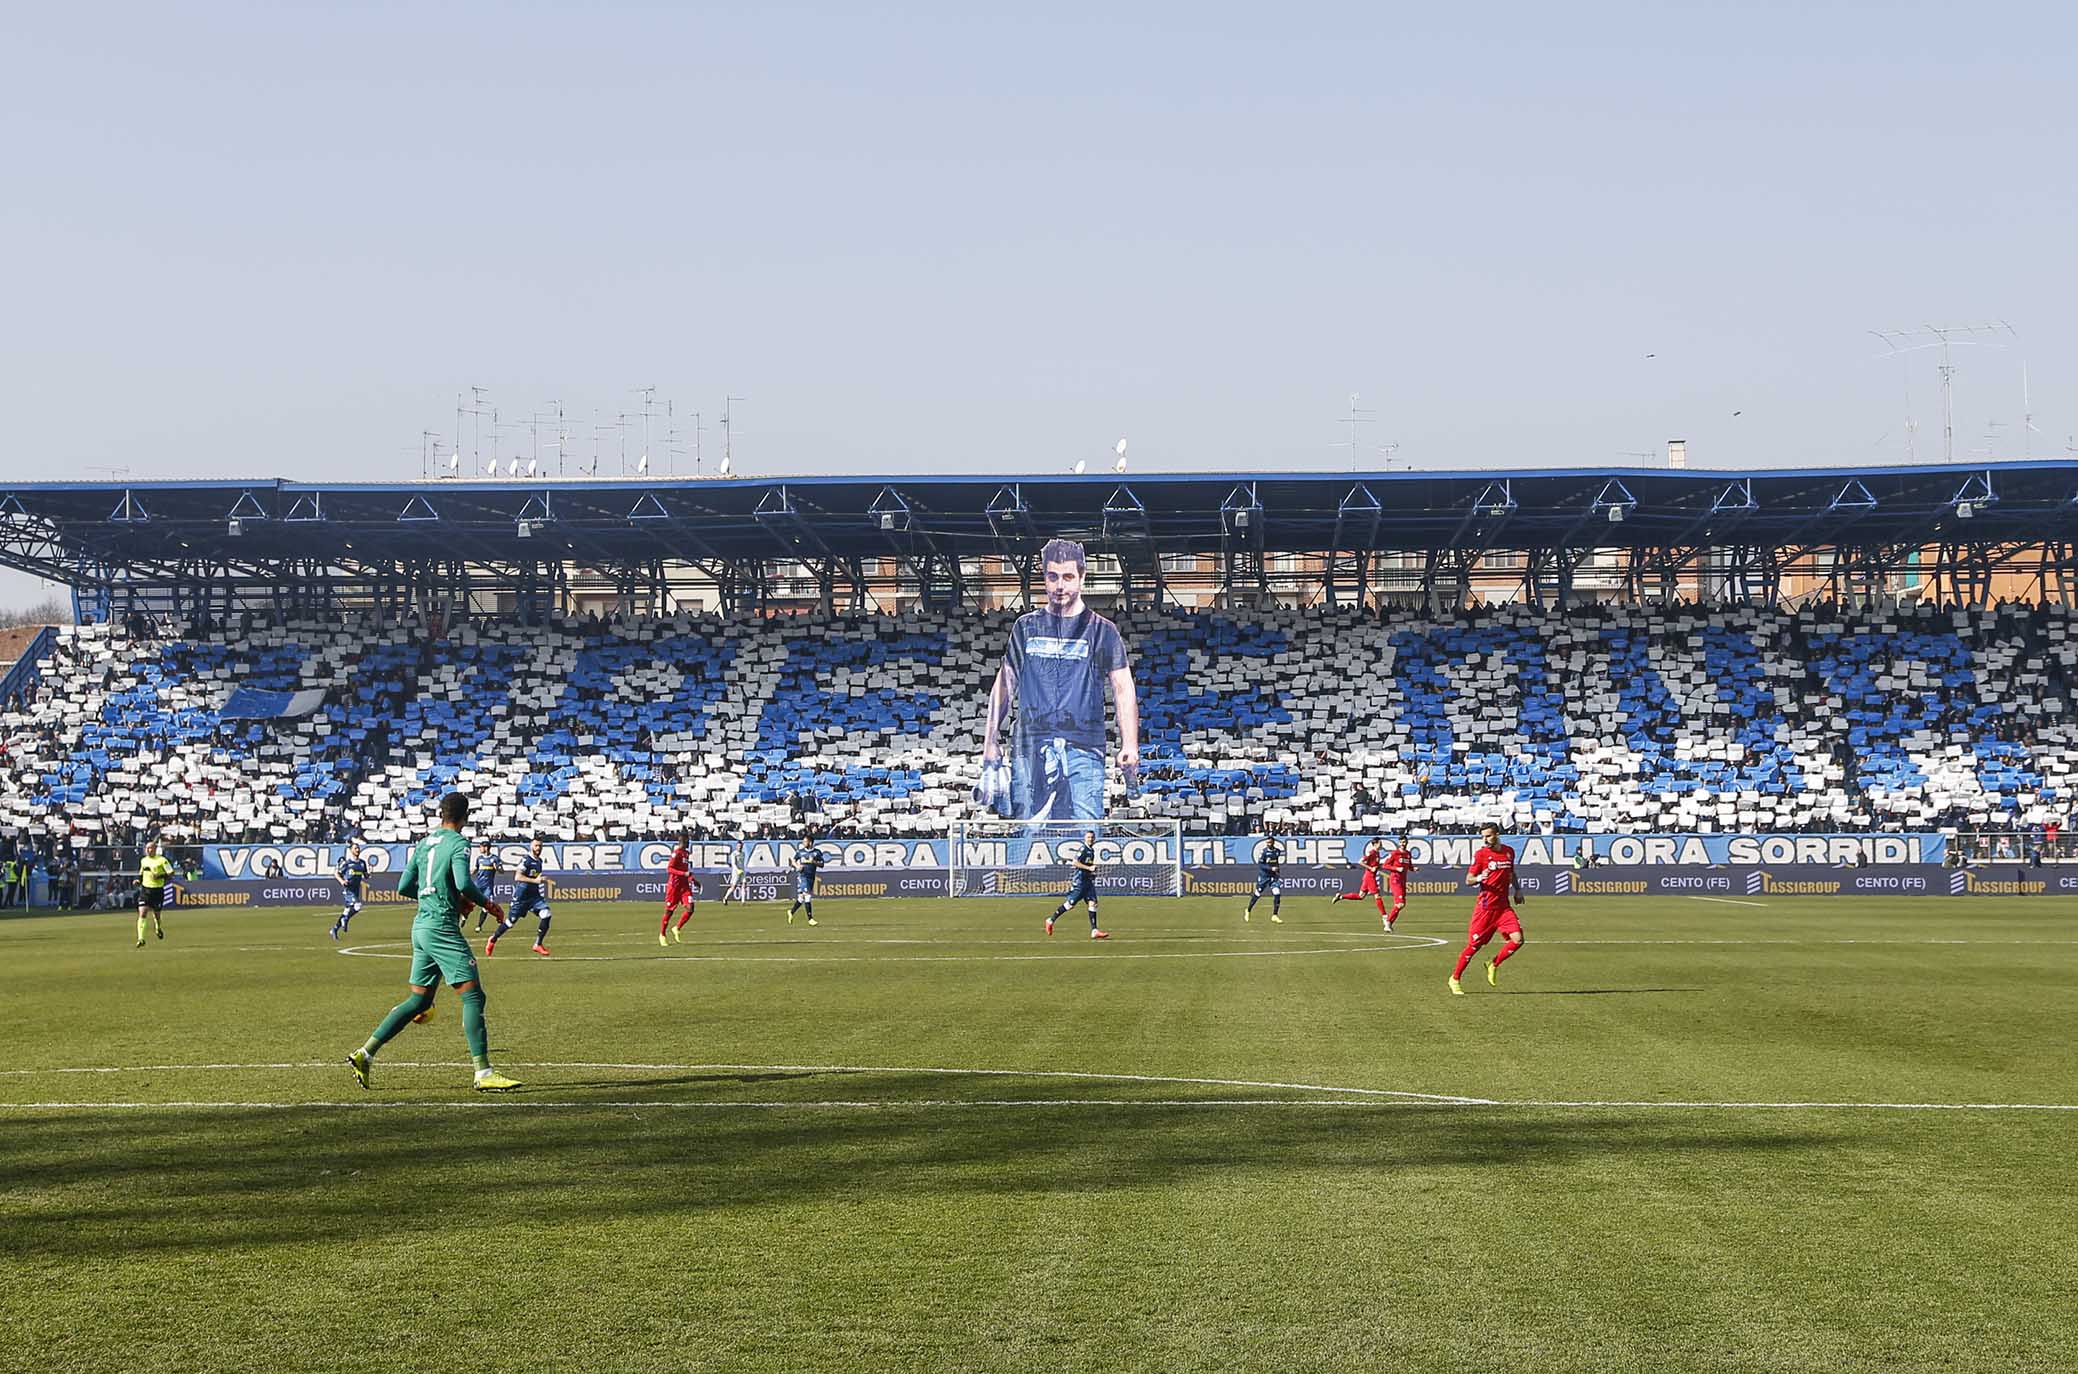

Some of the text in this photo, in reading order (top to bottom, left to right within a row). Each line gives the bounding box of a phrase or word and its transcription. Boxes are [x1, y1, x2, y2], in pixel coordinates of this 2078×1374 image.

[956, 841, 1006, 866] MI
[1519, 836, 1711, 865] ALLORA
[1728, 835, 1921, 864] SORRIDI
[636, 883, 668, 893] CENT
[900, 879, 941, 890] CENTO
[1094, 877, 1154, 889] ENTO (FE)
[1319, 877, 1344, 890] (FE)
[1568, 870, 1648, 893] TASSIGROUP
[1660, 877, 1730, 890] CENTO (FE)
[1760, 870, 1840, 893] TASSIGROUP
[1855, 877, 1926, 890] CENTO (FE)
[1963, 870, 2046, 893] TASSIGROUP
[173, 883, 250, 905] TASSIGROUP
[263, 887, 331, 900] CENTO (FE)
[545, 879, 622, 899] TASSIGROUP
